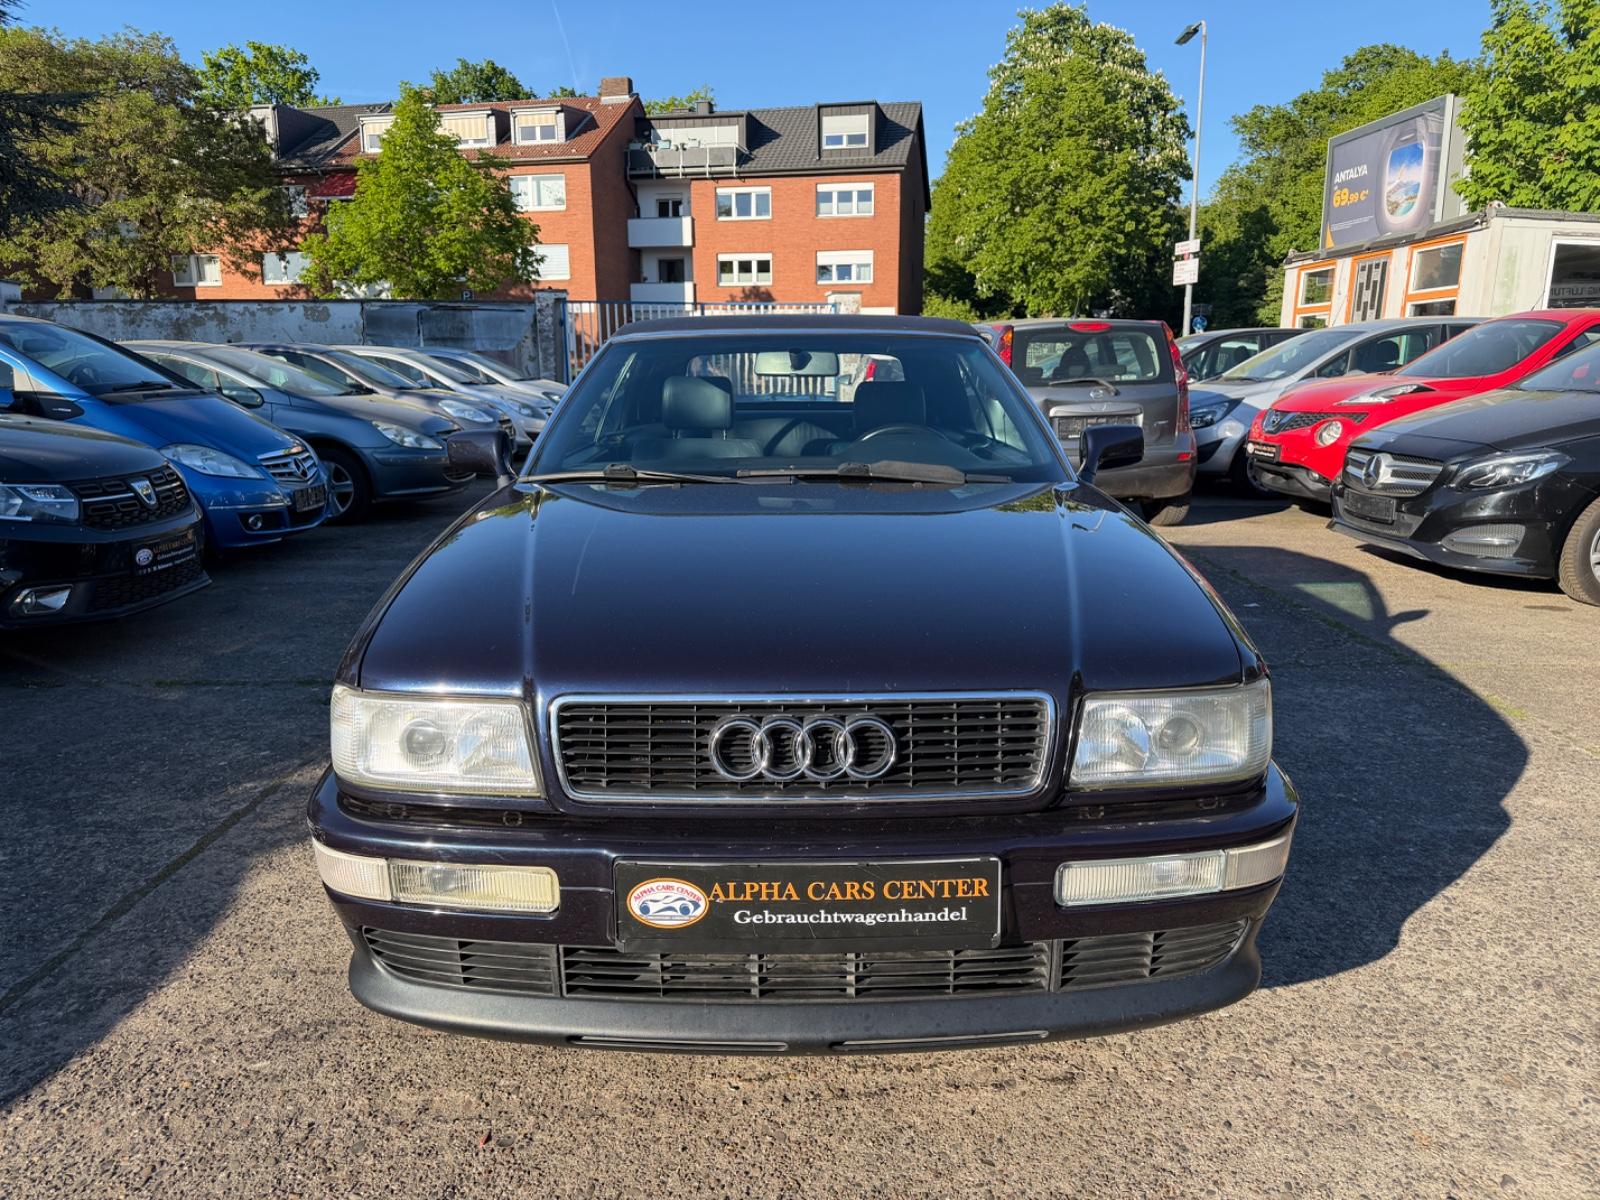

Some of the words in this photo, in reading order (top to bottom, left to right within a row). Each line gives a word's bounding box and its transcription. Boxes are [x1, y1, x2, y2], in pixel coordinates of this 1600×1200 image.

[1334, 164, 1368, 184] ANTALYA
[676, 887, 701, 902] CENTER
[709, 882, 800, 901] ALPHA
[807, 881, 876, 900] CARS
[883, 878, 989, 900] CENTER
[734, 907, 967, 926] Gebrauchtwagenhandel
